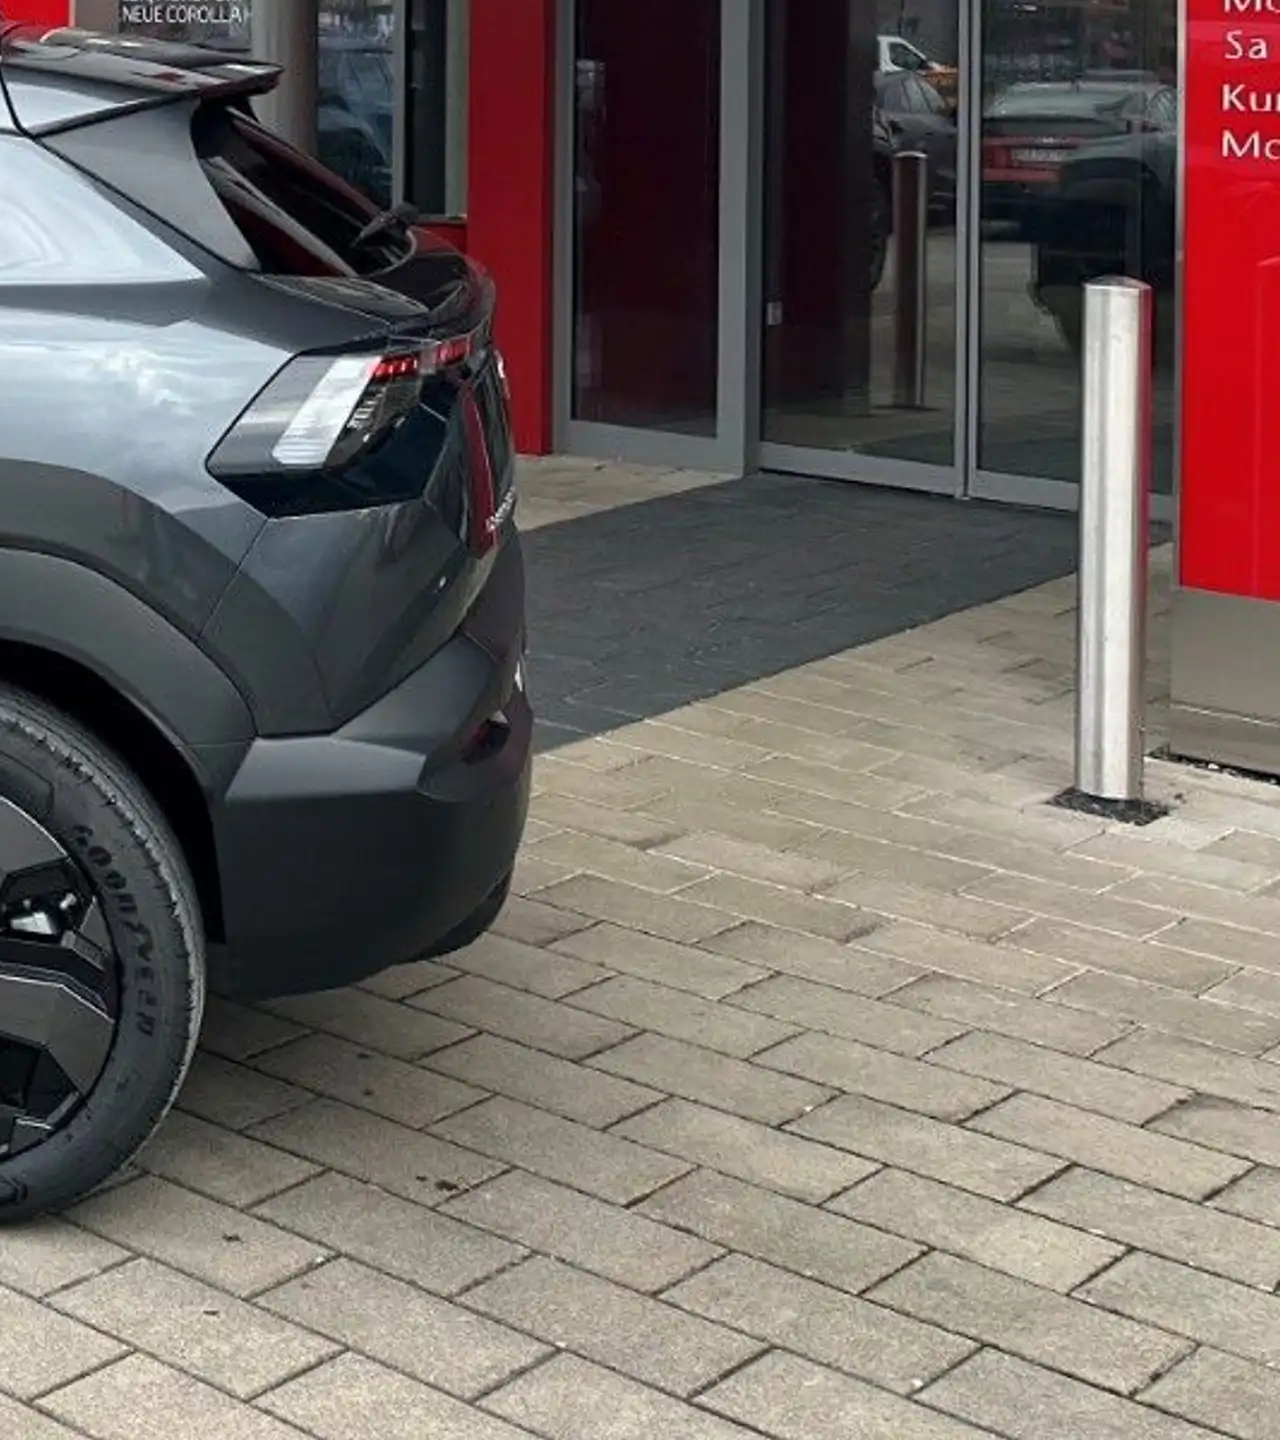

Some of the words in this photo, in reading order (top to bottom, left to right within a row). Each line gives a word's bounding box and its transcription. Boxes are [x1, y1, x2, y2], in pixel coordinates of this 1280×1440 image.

[123, 5, 162, 22] NEUE
[166, 5, 242, 23] COROLLA
[1225, 30, 1268, 59] Sa
